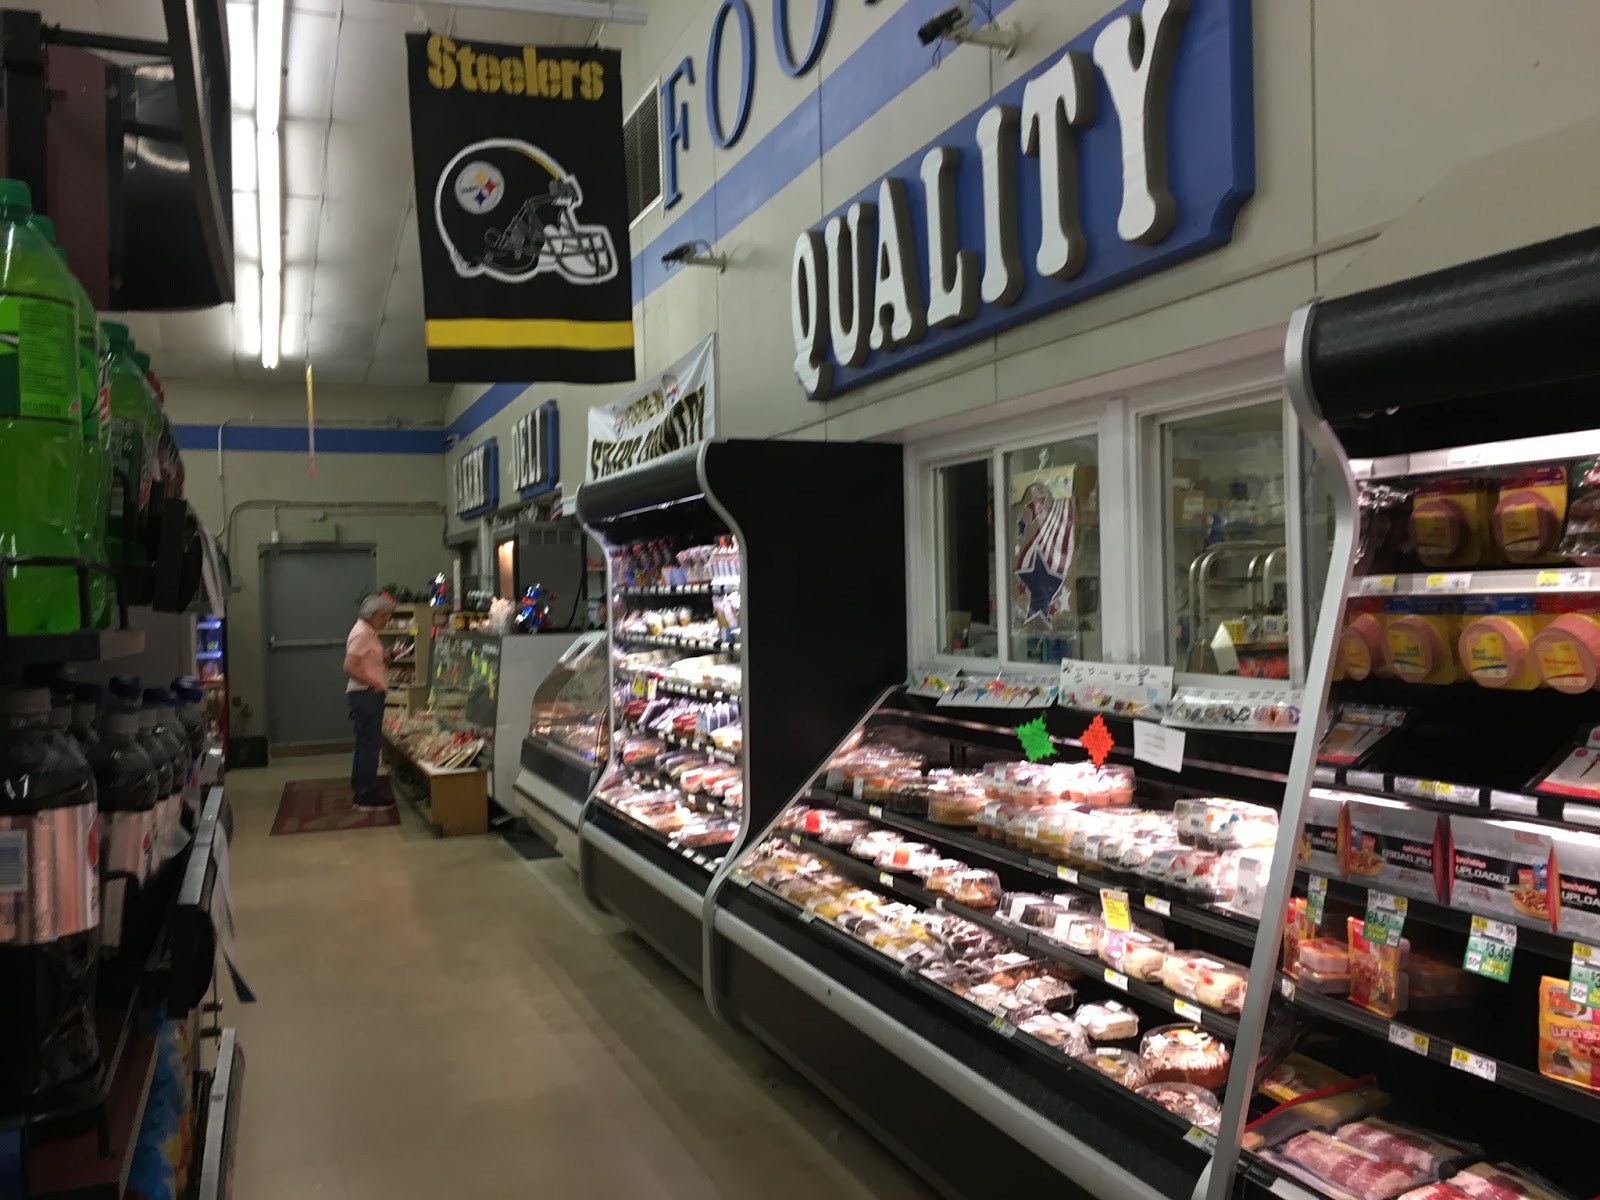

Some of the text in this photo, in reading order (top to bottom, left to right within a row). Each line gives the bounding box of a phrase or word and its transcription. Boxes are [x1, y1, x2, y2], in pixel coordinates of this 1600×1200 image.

[427, 33, 604, 101] Steelers
[661, 0, 882, 210] FOO
[791, 0, 1172, 397] QUALITY
[511, 407, 541, 493] DELI
[1455, 864, 1510, 885] UPLOADED
[1485, 942, 1511, 963] $3.49
